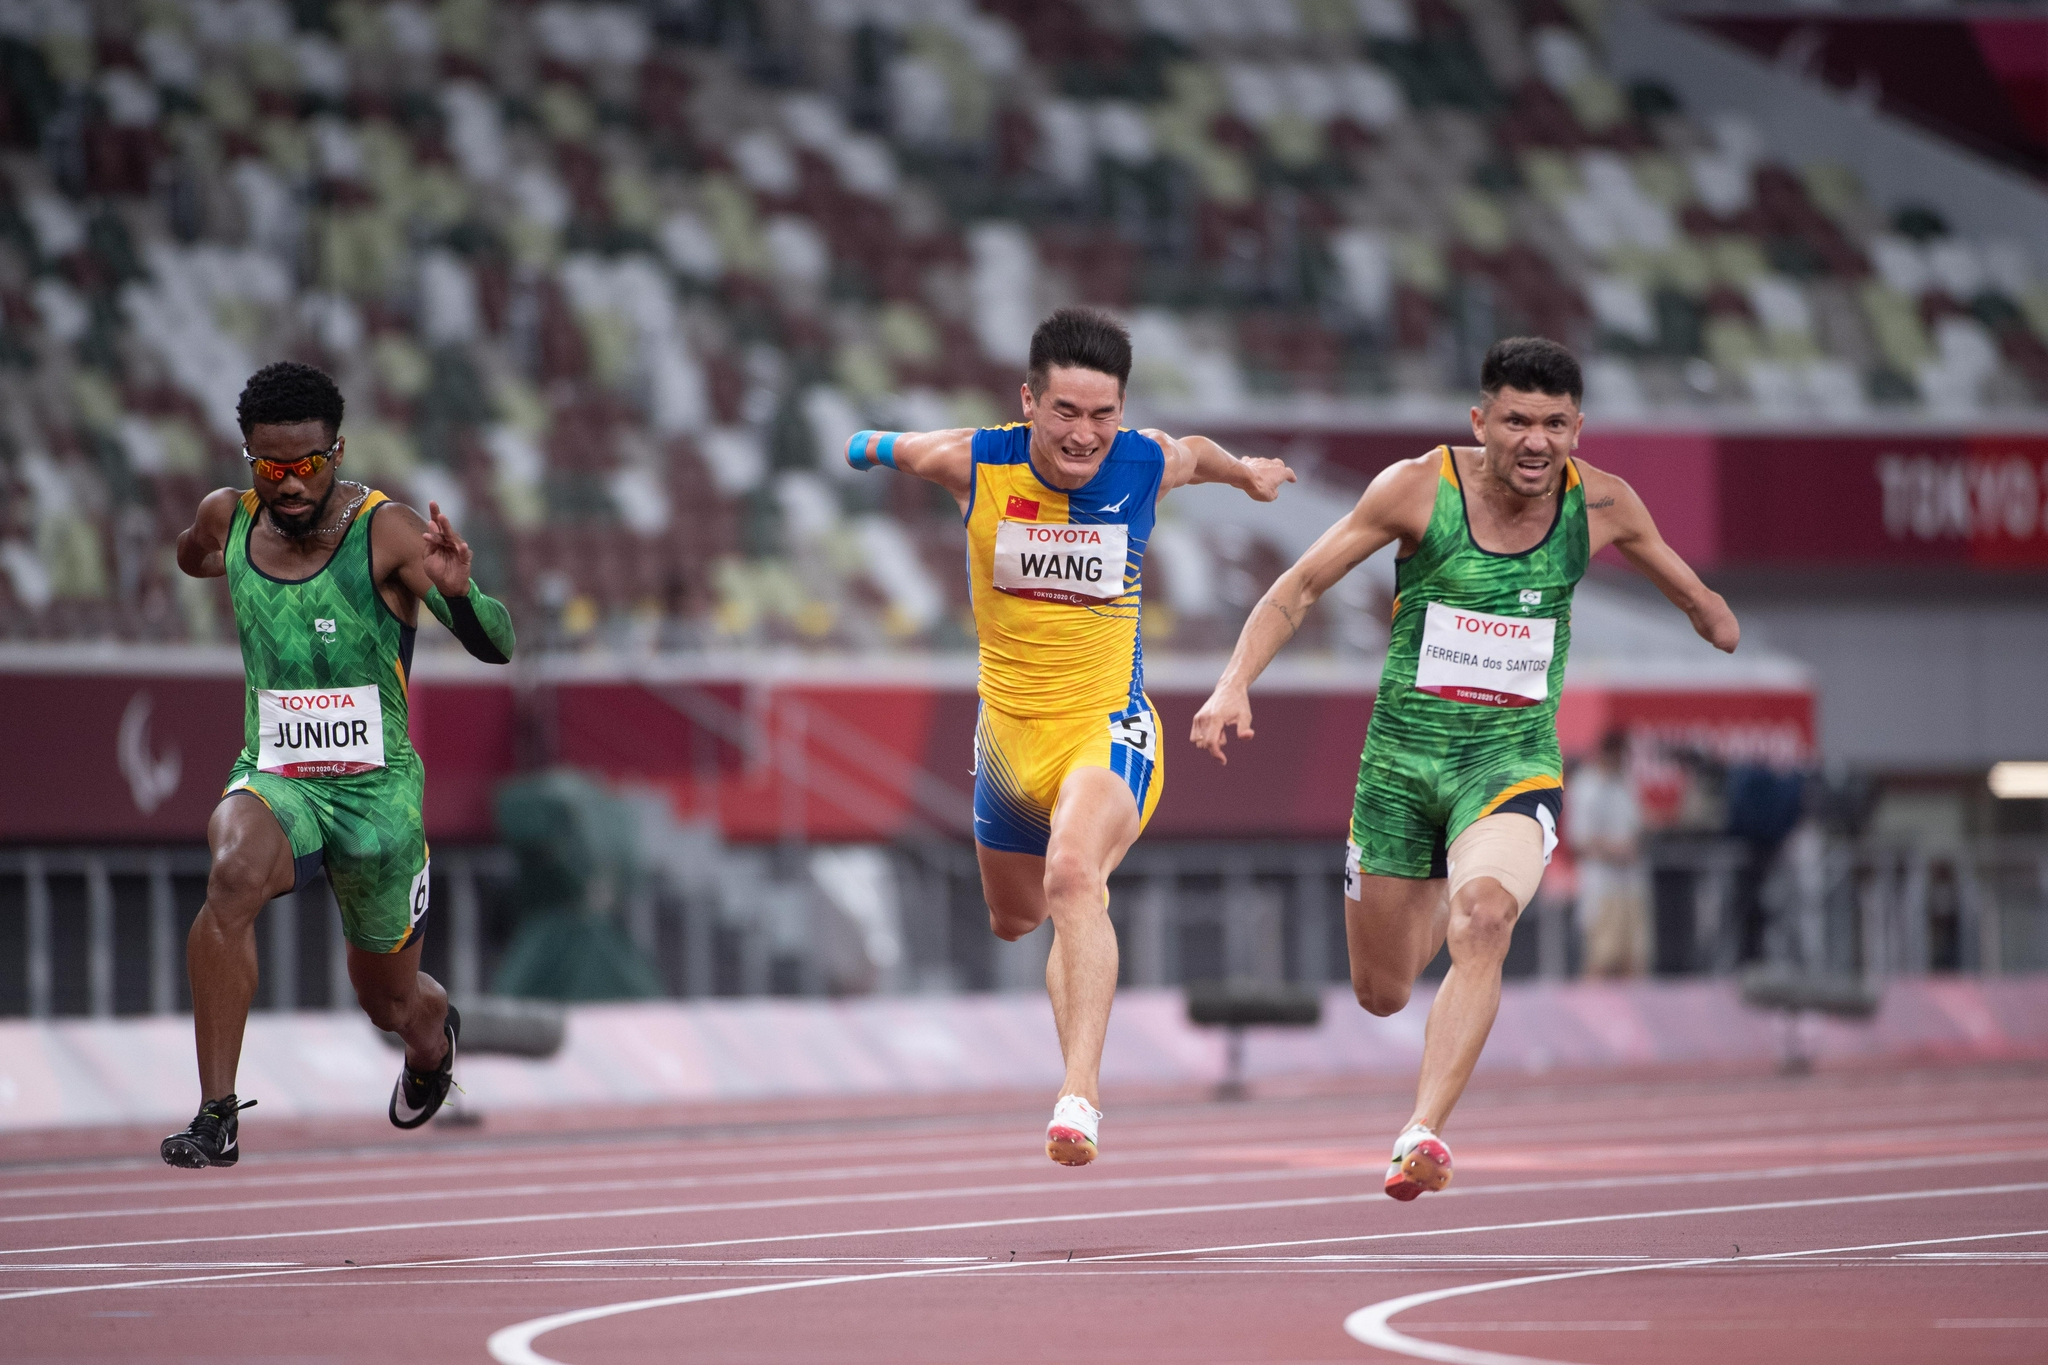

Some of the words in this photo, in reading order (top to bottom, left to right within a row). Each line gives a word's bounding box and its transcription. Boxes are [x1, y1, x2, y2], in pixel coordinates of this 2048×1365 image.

[1026, 528, 1101, 544] TOYOTA
[1021, 553, 1103, 583] WANG
[1033, 591, 1053, 599] TOKYO
[1455, 615, 1531, 639] TOYOTA
[1426, 644, 1478, 667] FERREIRA
[1483, 657, 1502, 670] dos
[1506, 659, 1547, 672] SANTOS
[278, 694, 355, 710] TOYOTA
[1456, 689, 1478, 699] TOKYO
[1477, 692, 1494, 702] 2020
[274, 719, 369, 749] JUNIOR
[1121, 716, 1148, 750] 5
[316, 765, 331, 773] 2020
[414, 872, 426, 916] 6
